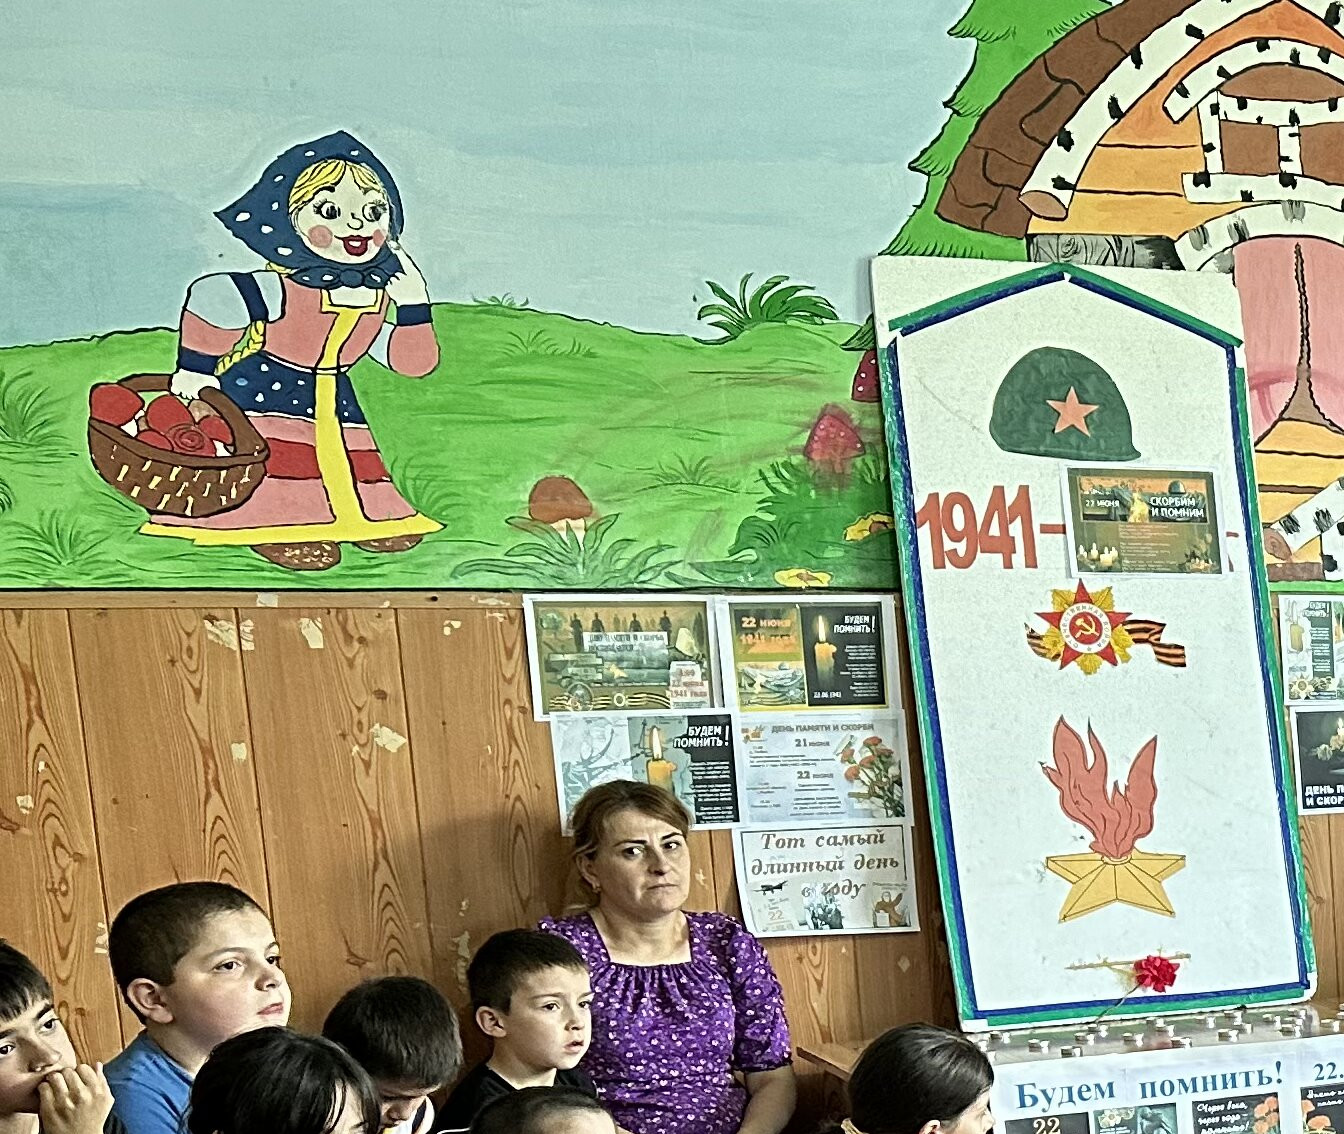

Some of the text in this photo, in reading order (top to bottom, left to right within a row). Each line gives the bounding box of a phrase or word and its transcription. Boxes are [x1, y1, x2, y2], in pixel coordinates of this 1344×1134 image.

[1151, 507, 1205, 518] И ПОМНИМ
[741, 616, 756, 628] 22
[844, 615, 870, 624] БУДЕМ
[688, 726, 722, 737] БУДЕМ
[796, 723, 831, 732] ПАМЯТИ
[833, 723, 840, 731] И
[795, 738, 807, 747] 21
[797, 771, 811, 779] 22
[1305, 786, 1334, 797] ДЕНЬ
[1306, 797, 1314, 807] И
[761, 829, 886, 850] Тот самый
[751, 853, 899, 876] длинный день
[801, 886, 811, 898] в
[821, 878, 866, 899] году
[1015, 1060, 1282, 1113] Будем помнить!
